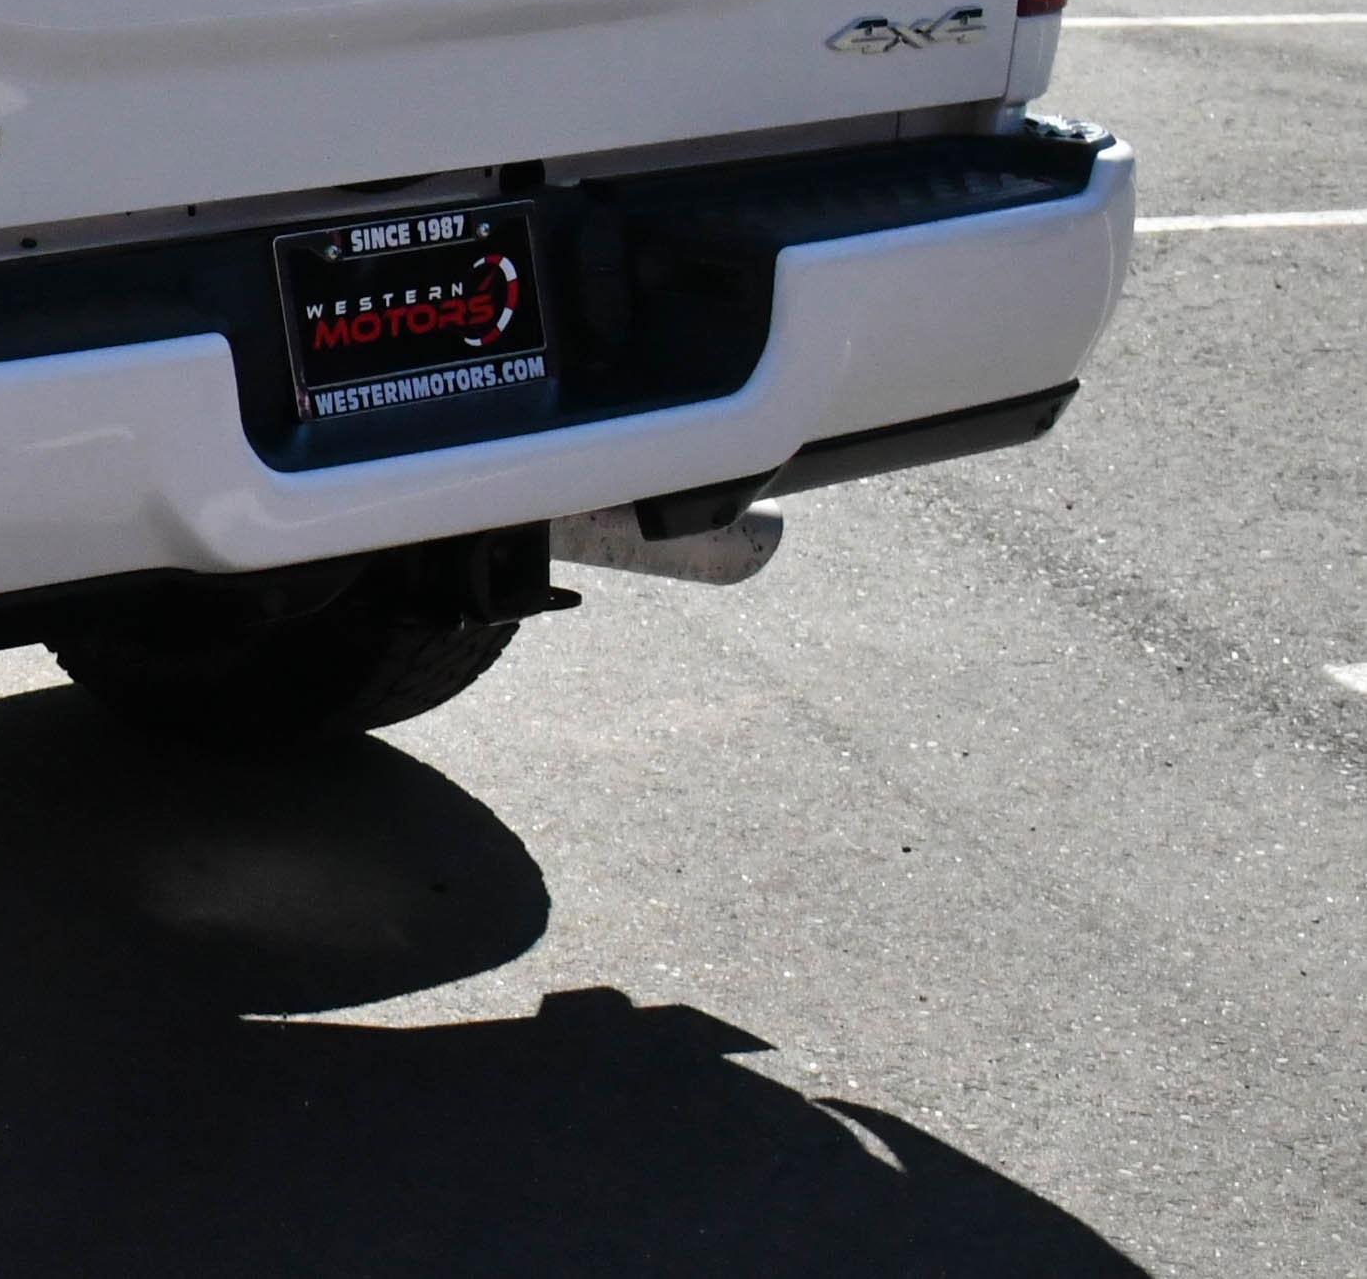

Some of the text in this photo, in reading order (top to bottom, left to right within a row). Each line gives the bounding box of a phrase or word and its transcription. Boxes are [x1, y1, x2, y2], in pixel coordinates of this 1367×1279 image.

[350, 214, 465, 253] SINCE 1987
[306, 281, 464, 319] WESTERN
[314, 294, 495, 350] MOTORS
[314, 356, 545, 416] WESTERNMOTORS.COM
